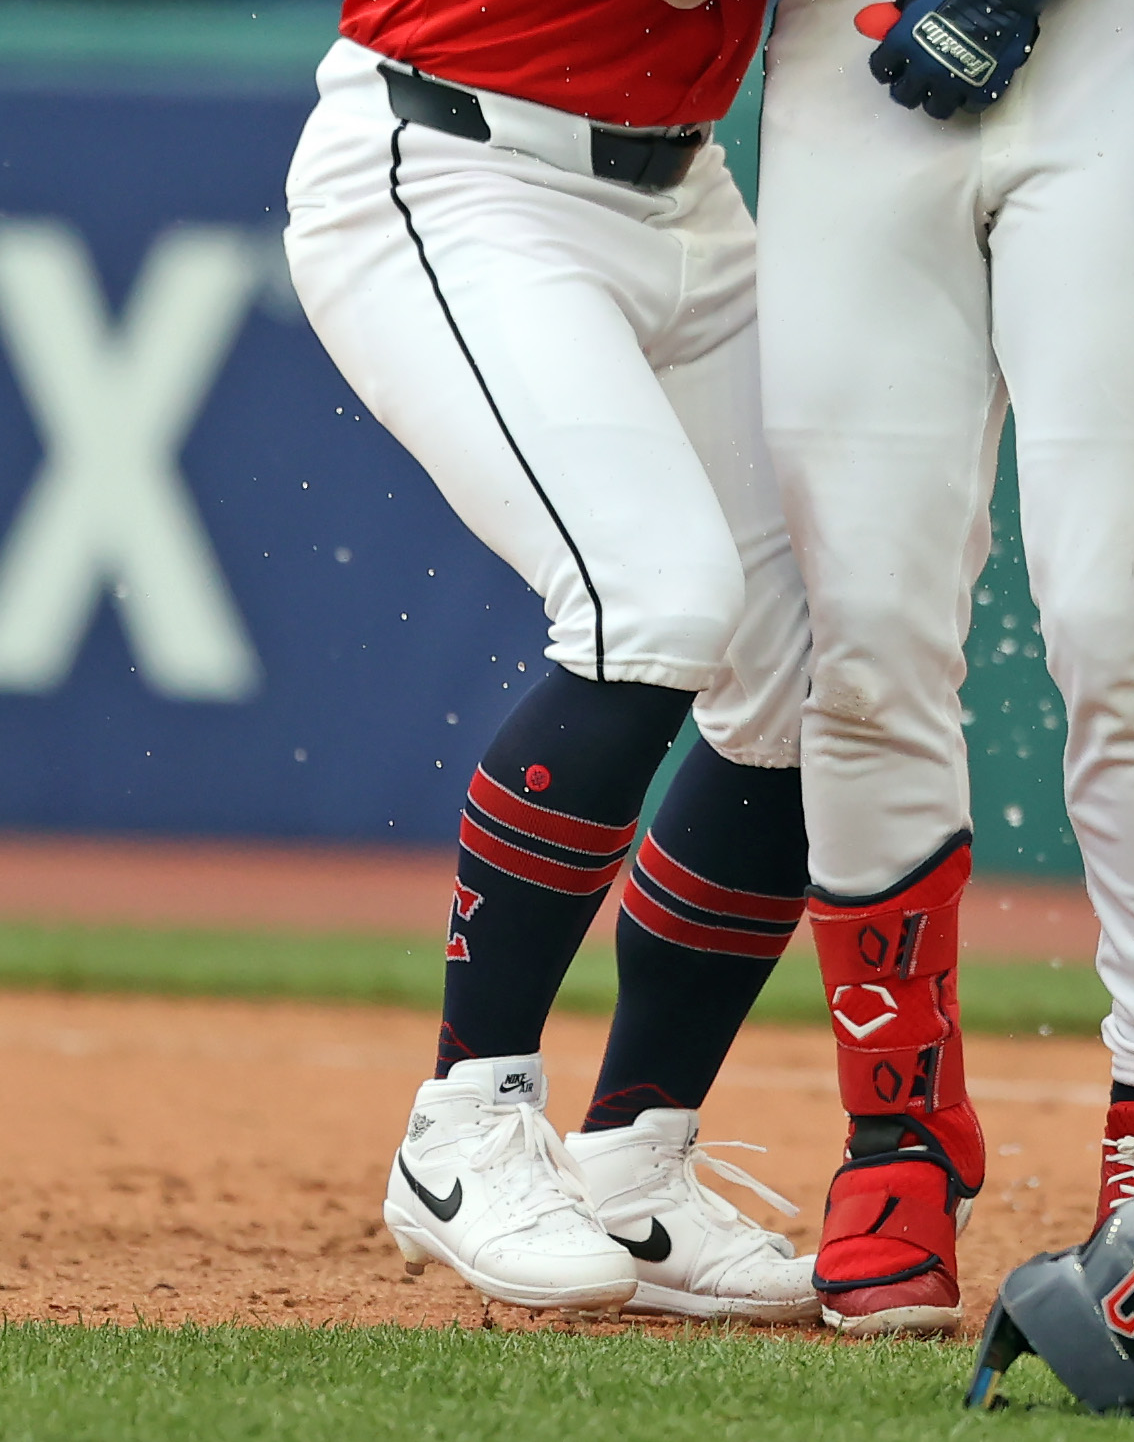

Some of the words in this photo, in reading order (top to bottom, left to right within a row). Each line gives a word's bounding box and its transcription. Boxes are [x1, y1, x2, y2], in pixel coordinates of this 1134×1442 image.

[921, 20, 992, 78] Franklin
[504, 1073, 528, 1085] NIKE
[519, 1082, 534, 1094] AIR
